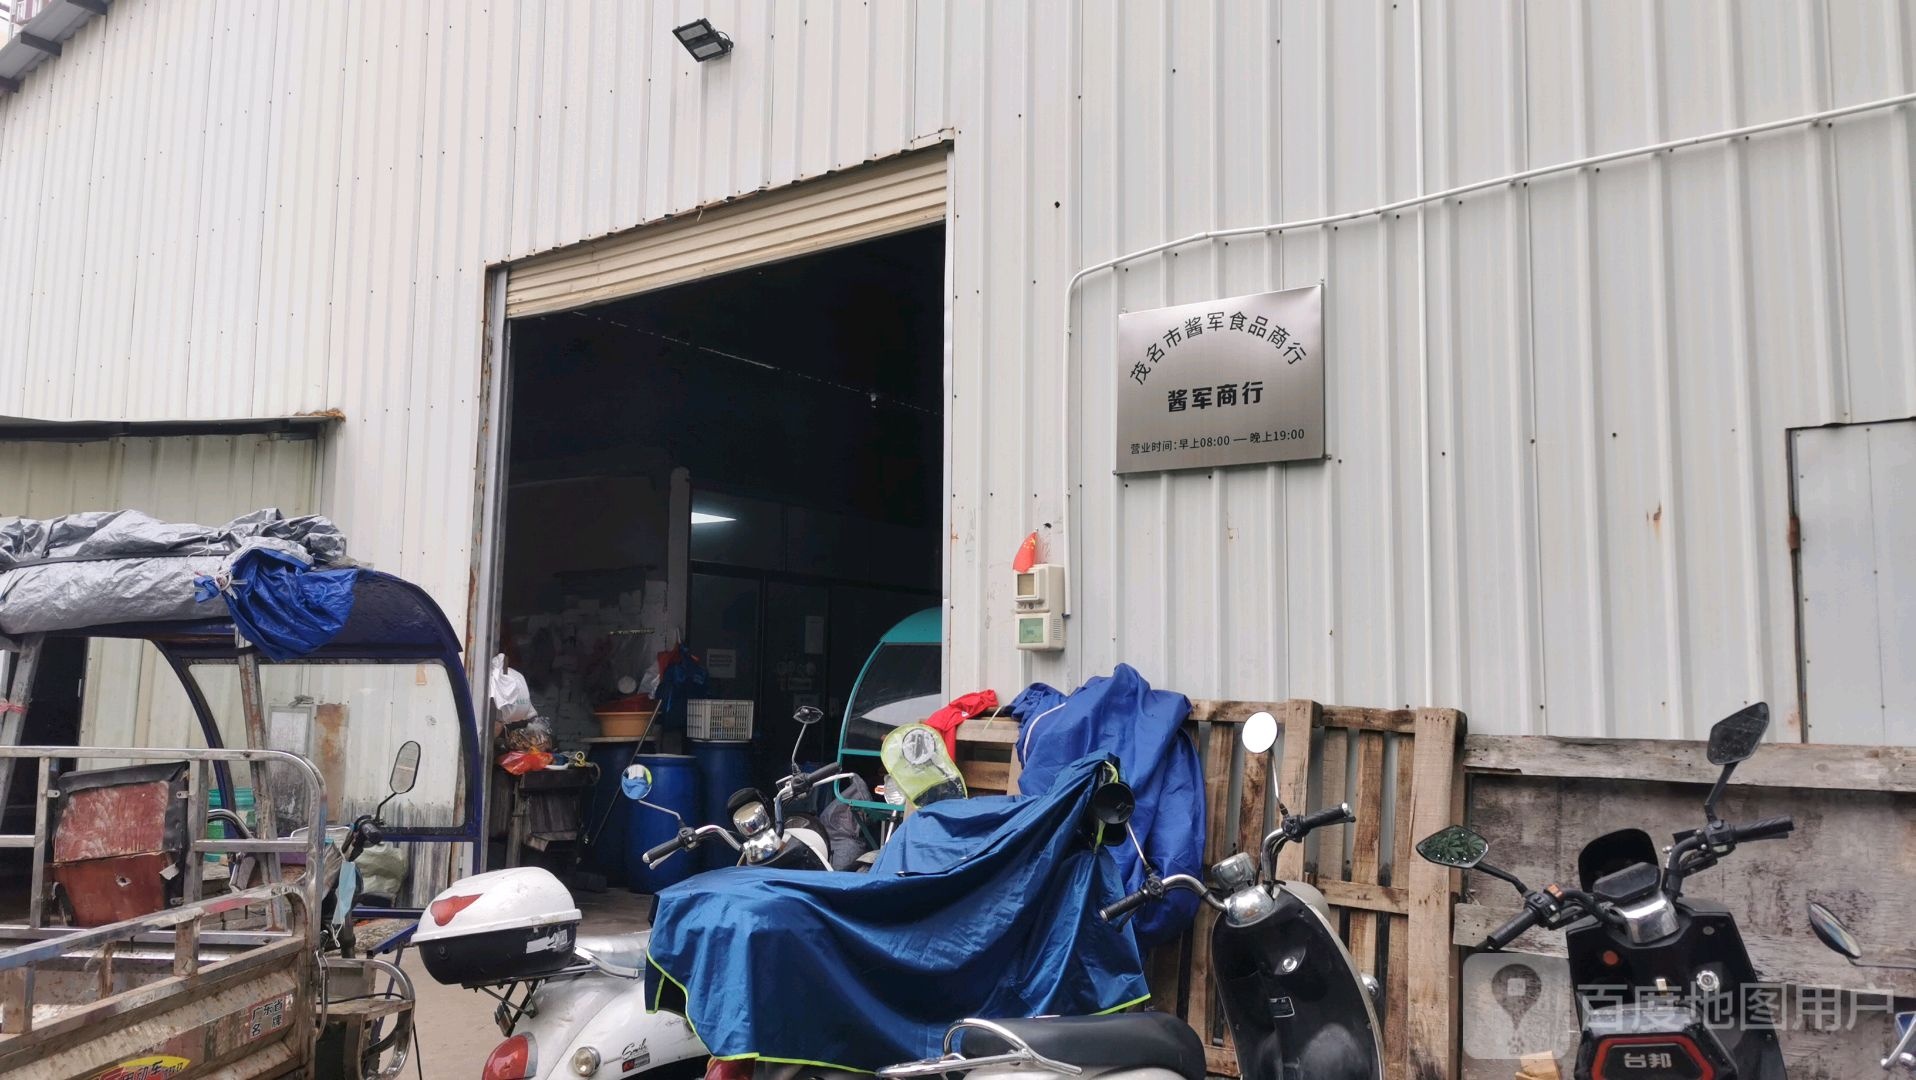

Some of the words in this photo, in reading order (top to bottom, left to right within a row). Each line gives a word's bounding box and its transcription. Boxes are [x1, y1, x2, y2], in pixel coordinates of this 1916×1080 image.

[1130, 311, 1307, 385] 茂名市酱军食品商行
[1168, 381, 1264, 412] 酱军商行
[252, 998, 283, 1020] 广东省
[1624, 1052, 1672, 1069] 台邦
